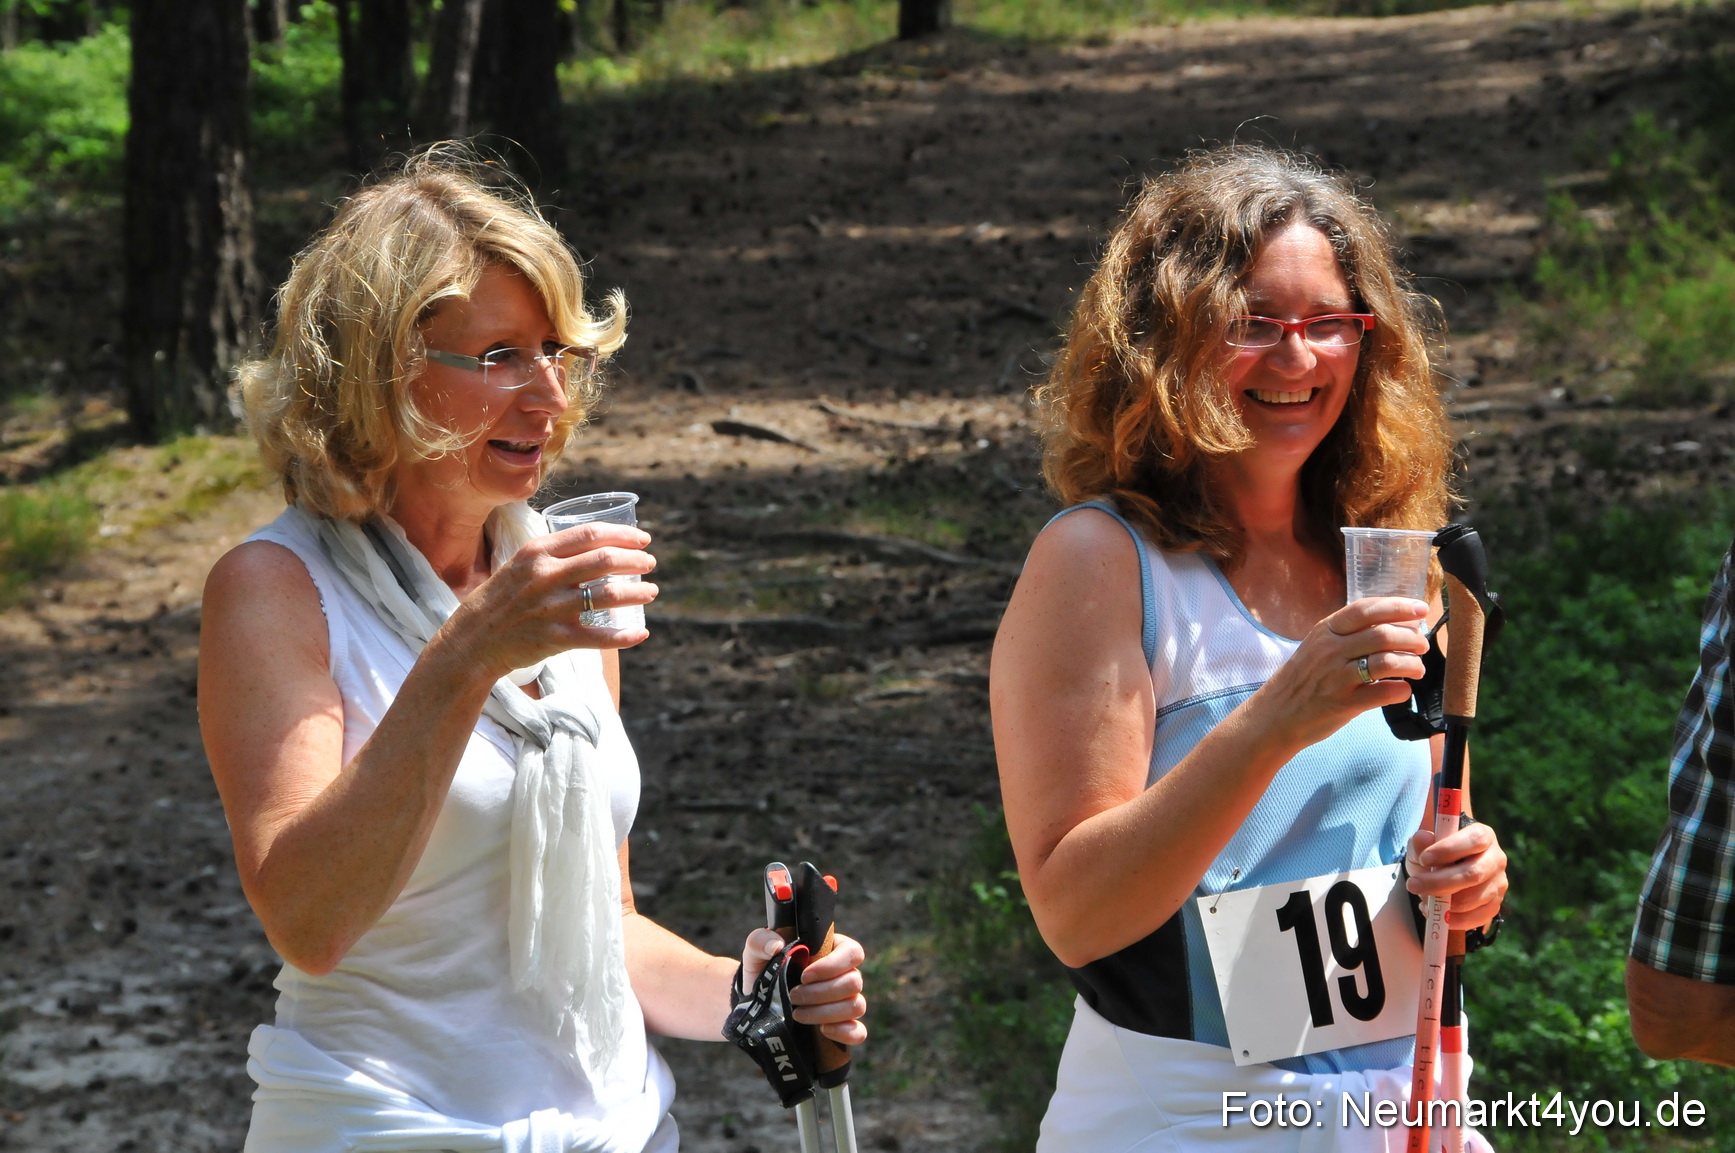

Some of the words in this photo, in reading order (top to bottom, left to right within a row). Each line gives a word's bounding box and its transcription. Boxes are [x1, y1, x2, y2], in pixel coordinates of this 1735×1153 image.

[1276, 880, 1386, 1029] 19
[736, 969, 773, 1035] LEKI
[1424, 964, 1441, 1021] feel
